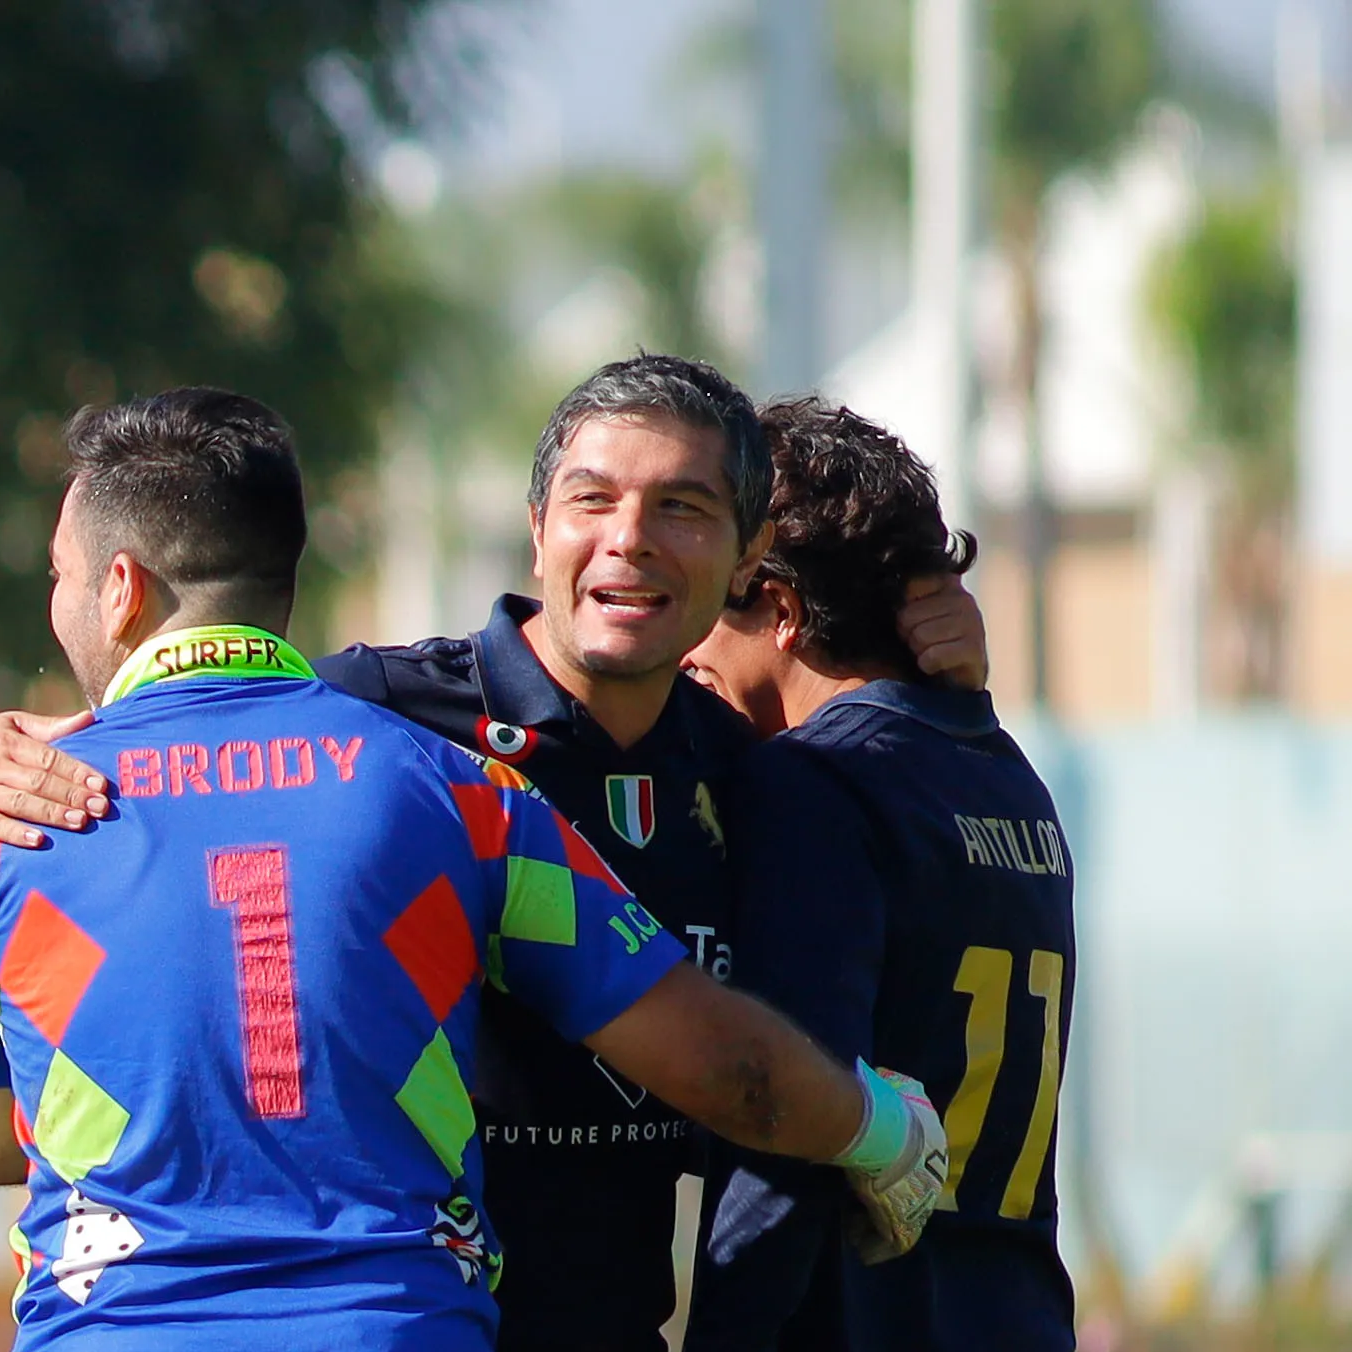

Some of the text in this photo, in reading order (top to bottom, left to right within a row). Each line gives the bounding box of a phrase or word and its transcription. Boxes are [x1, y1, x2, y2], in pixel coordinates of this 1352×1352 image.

[117, 735, 365, 797] BRODY
[206, 843, 306, 1119] 1
[685, 924, 733, 983] Ta
[933, 945, 1064, 1220] 11
[485, 1120, 689, 1145] FUTURE PROYEC
